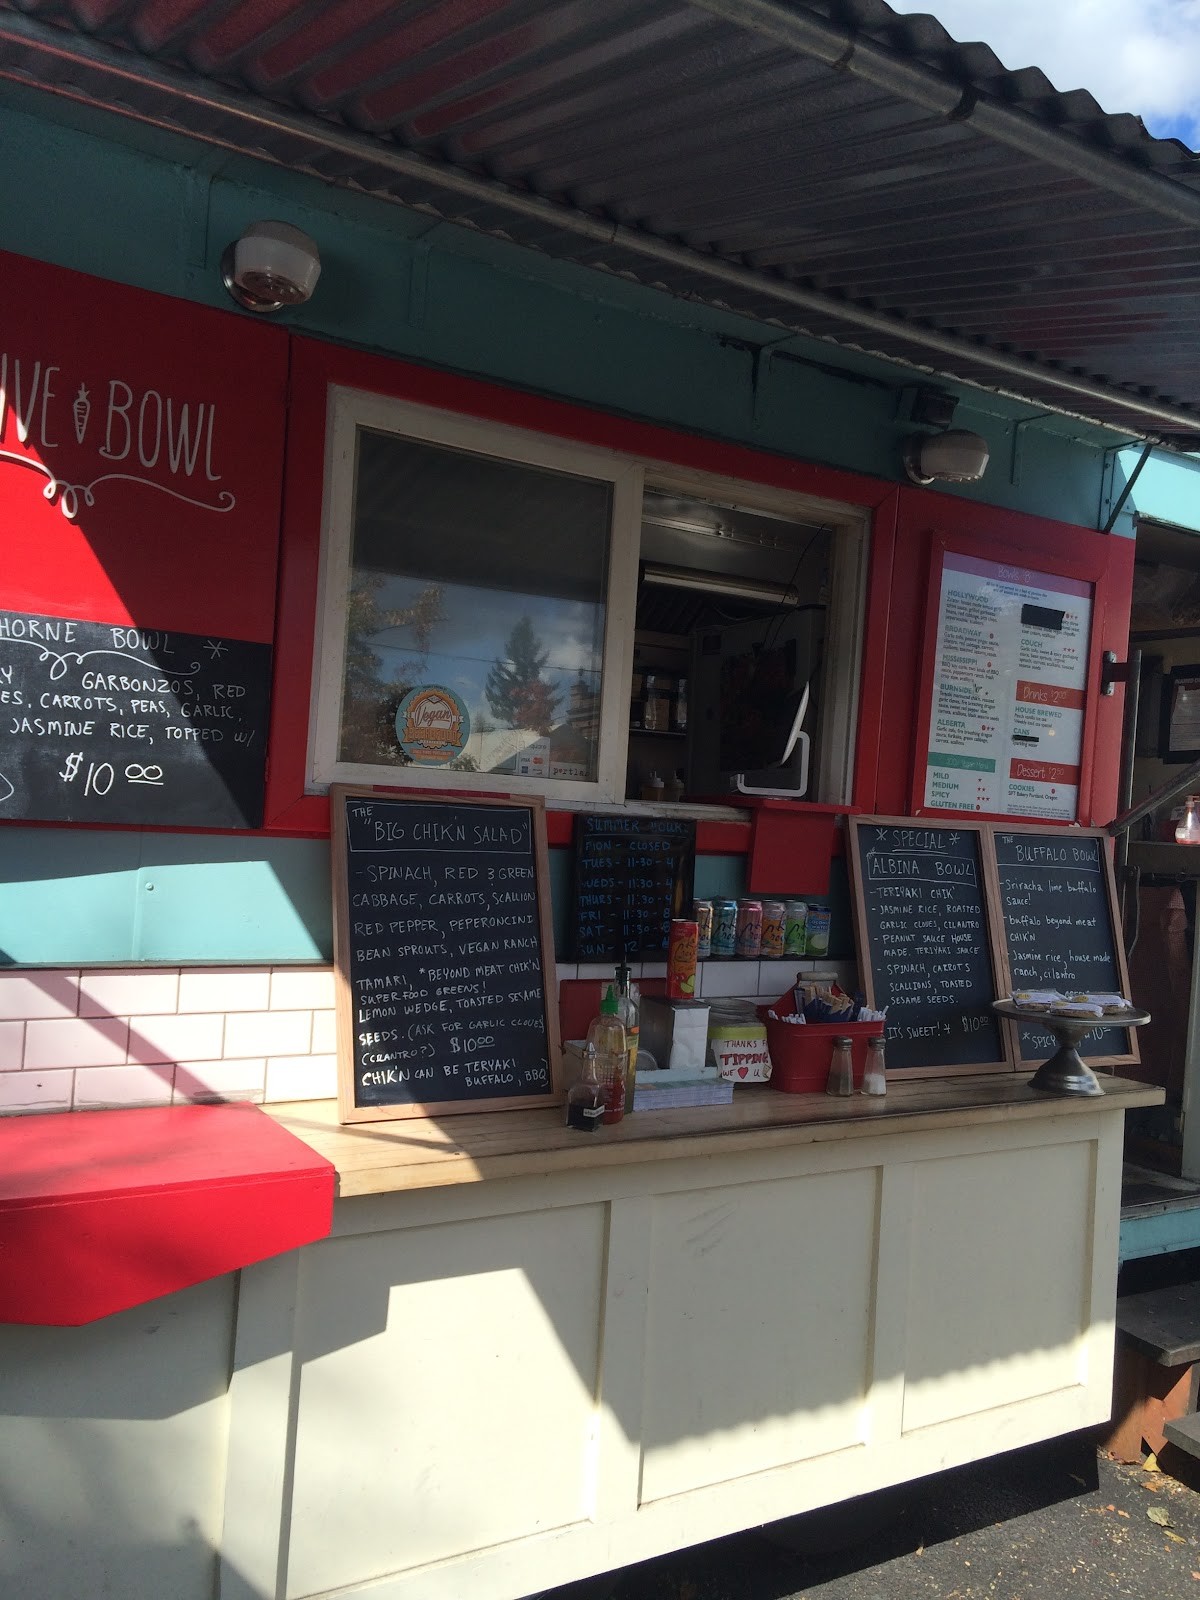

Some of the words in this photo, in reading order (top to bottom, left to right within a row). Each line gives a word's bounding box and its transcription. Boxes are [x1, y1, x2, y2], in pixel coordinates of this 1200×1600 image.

[99, 380, 221, 480] BOWL
[948, 590, 989, 603] HOLLYWOOD
[945, 624, 982, 637] BROADWAY
[110, 627, 175, 654] BOWL
[1021, 639, 1043, 648] COUCH
[943, 654, 977, 665] MISSISSIPPI
[213, 684, 246, 700] RED
[940, 683, 972, 694] BURNSIDE
[1023, 686, 1048, 702] Drinks
[40, 692, 124, 715] CARROTS,
[131, 699, 170, 718] PEAS,
[416, 706, 451, 726] Vegan
[1015, 706, 1036, 715] HOUSE
[1037, 709, 1062, 719] BREWED
[937, 719, 966, 729] ALBERTA
[9, 717, 96, 736] JASMINE
[110, 724, 153, 745] RICE,
[165, 726, 224, 742] TOPPED
[1013, 728, 1030, 736] CANS
[58, 751, 115, 796] $10
[1017, 764, 1046, 779] Dessert
[932, 782, 959, 790] MEDIUM
[1009, 784, 1035, 792] COOKIES
[931, 800, 957, 809] GLUTEN
[352, 806, 374, 818] THE
[586, 818, 640, 833] SUMMER
[630, 841, 671, 850] CLOSED
[892, 830, 946, 849] SPECIAL
[1002, 836, 1014, 844] THE
[1016, 845, 1067, 862] BUFFALO
[1072, 847, 1099, 862] BOWL
[666, 858, 674, 868] 4
[873, 858, 920, 874] ALBINA
[935, 862, 974, 876] BOWL
[445, 867, 479, 880] RED
[498, 867, 534, 880] GREEN
[666, 878, 673, 889] 4
[1049, 880, 1062, 893] lime
[1067, 880, 1097, 893] buffalo
[353, 893, 423, 910] CABBAGE,
[428, 893, 490, 911] CARROTS,
[665, 894, 672, 905] 4
[579, 912, 601, 922] FRI
[663, 909, 670, 919] 8
[880, 905, 913, 915] JASMINE
[947, 905, 980, 914] ROASTED
[354, 922, 384, 936] RED
[880, 921, 908, 929] GARLIC
[944, 921, 980, 929] CILANTRO
[1046, 916, 1073, 929] beyond
[1075, 917, 1096, 927] meat
[579, 925, 605, 938] SAT
[883, 934, 916, 944] PEANUT
[923, 935, 946, 943] SAUCE
[951, 934, 973, 944] HOUSE
[357, 947, 391, 961] BEAN
[398, 944, 454, 957] SPROUTS,
[459, 940, 500, 955] VEGAN
[504, 936, 538, 949] RANCH
[624, 941, 638, 952] 12
[915, 947, 951, 955] TERIYAKI
[956, 947, 981, 955] SAUCE
[1069, 950, 1091, 962] house
[1093, 952, 1111, 963] made
[933, 963, 971, 973] CARROTS
[1043, 968, 1076, 979] cilantro
[356, 975, 413, 991] TAMARI,
[475, 964, 504, 977] MEAT
[940, 980, 973, 989] TOASTED
[360, 992, 401, 1005] SUPER
[436, 981, 486, 996] GREENS!
[890, 996, 921, 1005] SESAME
[358, 1006, 397, 1023] LEMON
[404, 1000, 453, 1016] WEDGE,
[455, 995, 504, 1009] TOASTED
[358, 1029, 405, 1047] SEEDS.
[442, 1022, 463, 1032] FOR
[468, 1019, 506, 1030] GARLIC
[724, 1040, 757, 1048] THANKS
[414, 1067, 434, 1080] CAN
[443, 1064, 459, 1077] BE
[525, 1068, 546, 1080] BBQ
[754, 1069, 760, 1077] U
